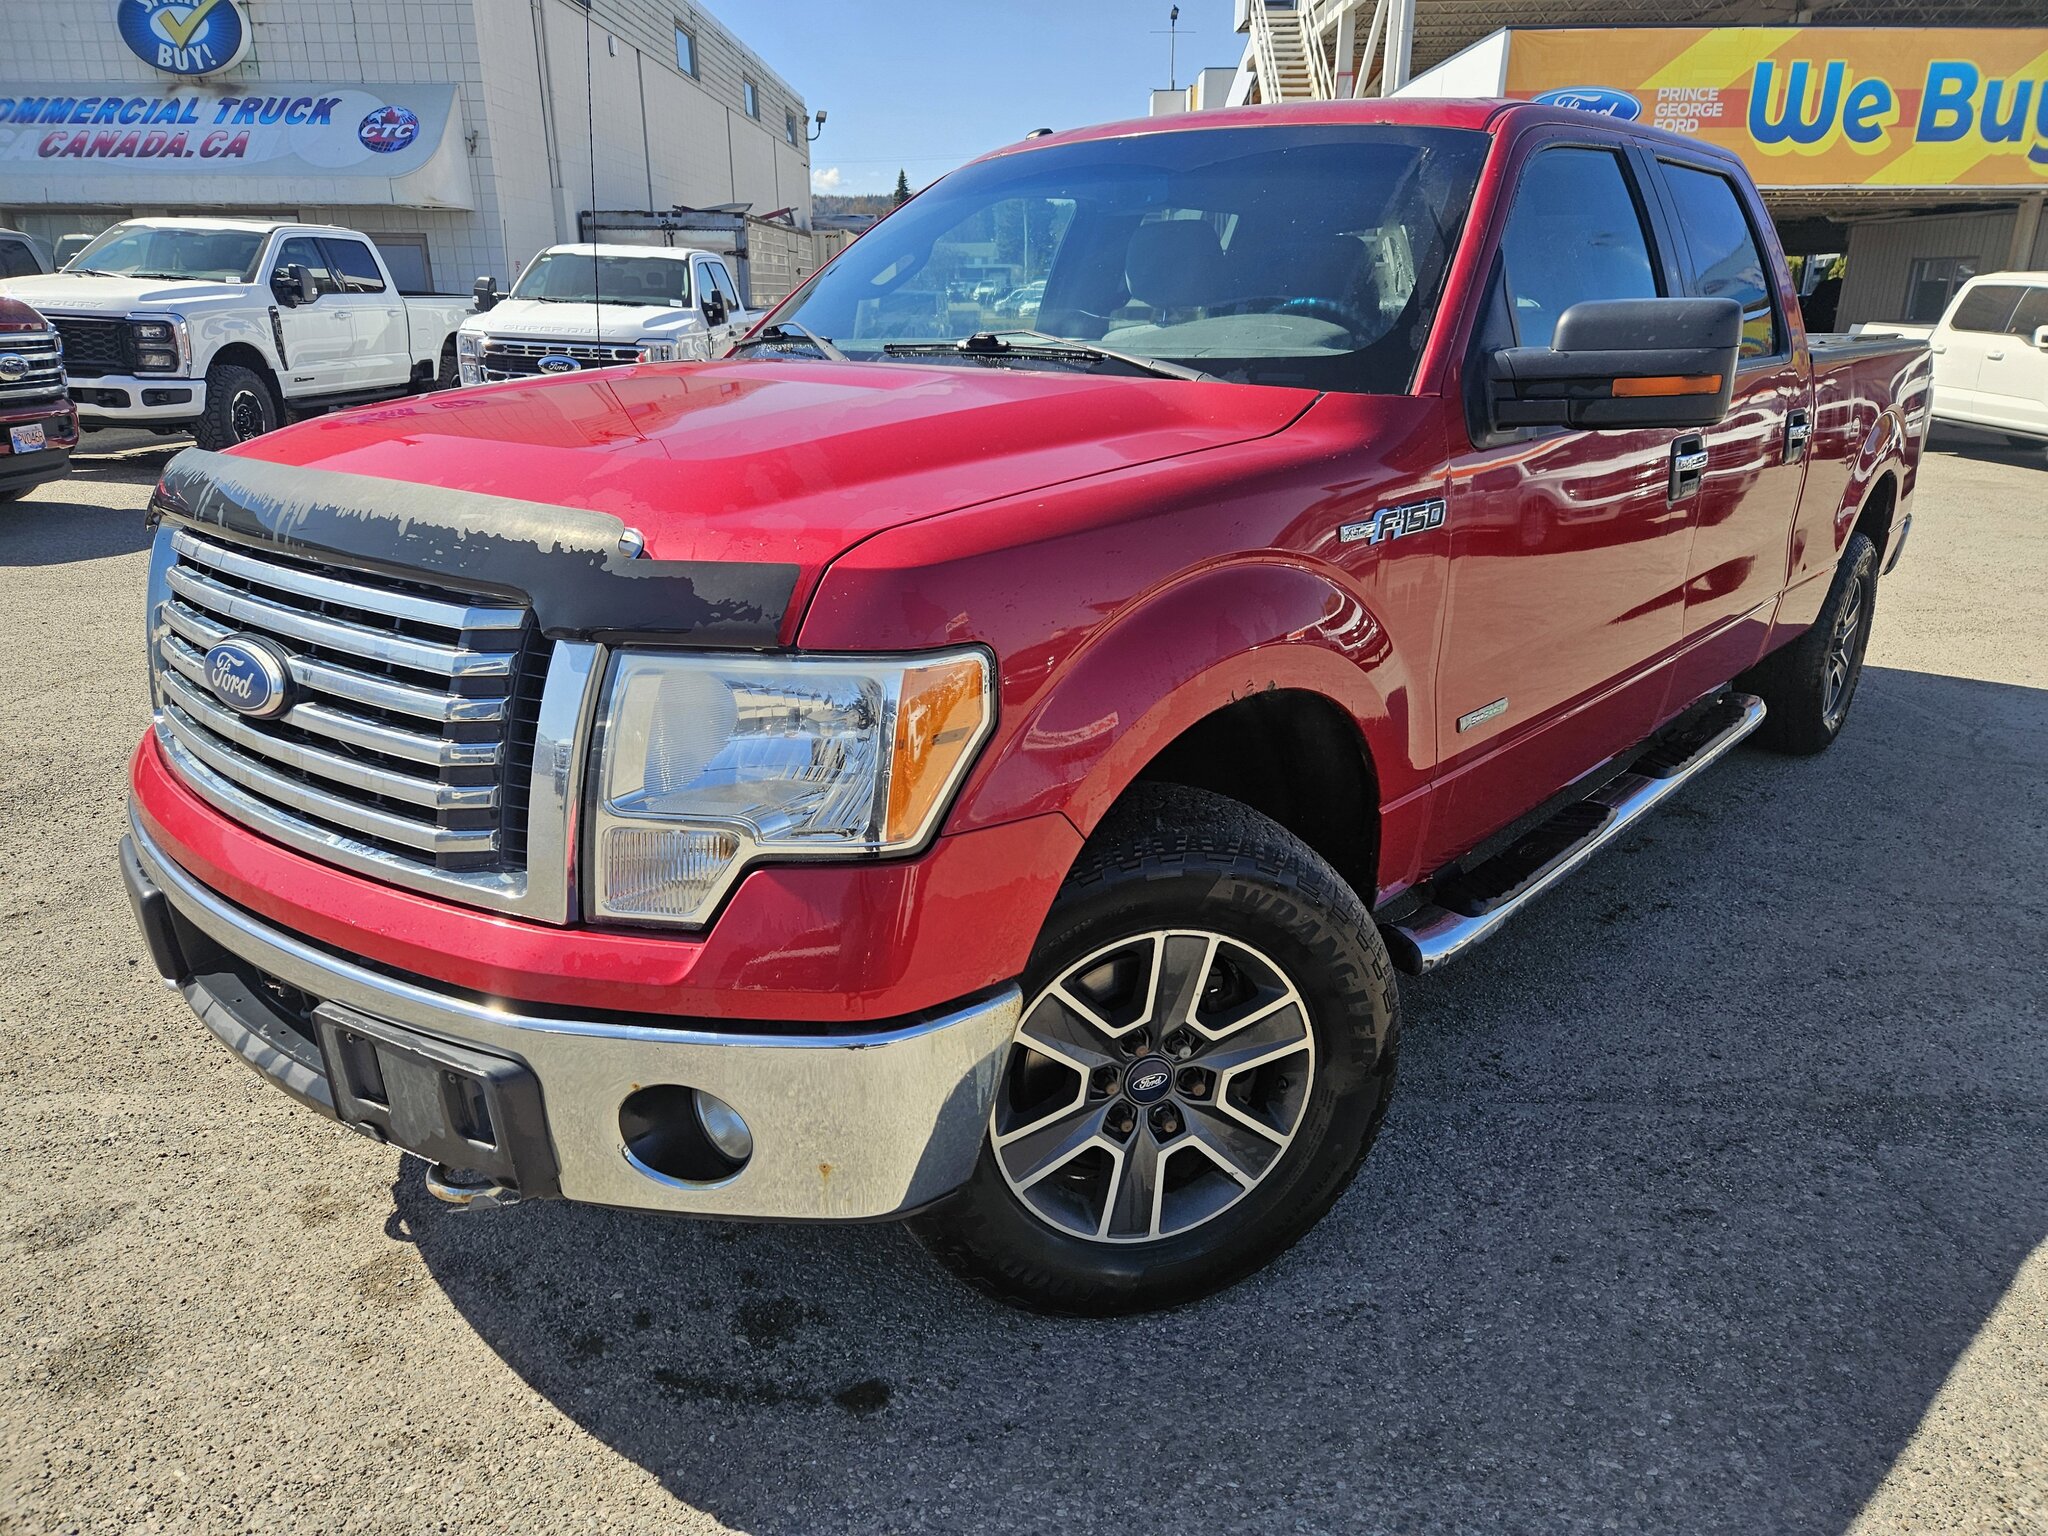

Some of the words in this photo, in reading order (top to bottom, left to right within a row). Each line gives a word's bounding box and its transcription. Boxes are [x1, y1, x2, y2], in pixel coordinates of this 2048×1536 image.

[157, 42, 217, 71] BUY!
[1657, 88, 1719, 101] PRINCE
[1749, 61, 1892, 144] We
[213, 97, 342, 125] TRUCK
[1553, 94, 1619, 117] Fd
[1655, 103, 1723, 117] GEORGE
[361, 123, 415, 138] CTC
[1653, 118, 1699, 133] FORD
[37, 130, 250, 159] CANADA.CA
[548, 361, 569, 371] Ford
[212, 651, 254, 699] Ford
[1139, 1075, 1162, 1089] Ford
